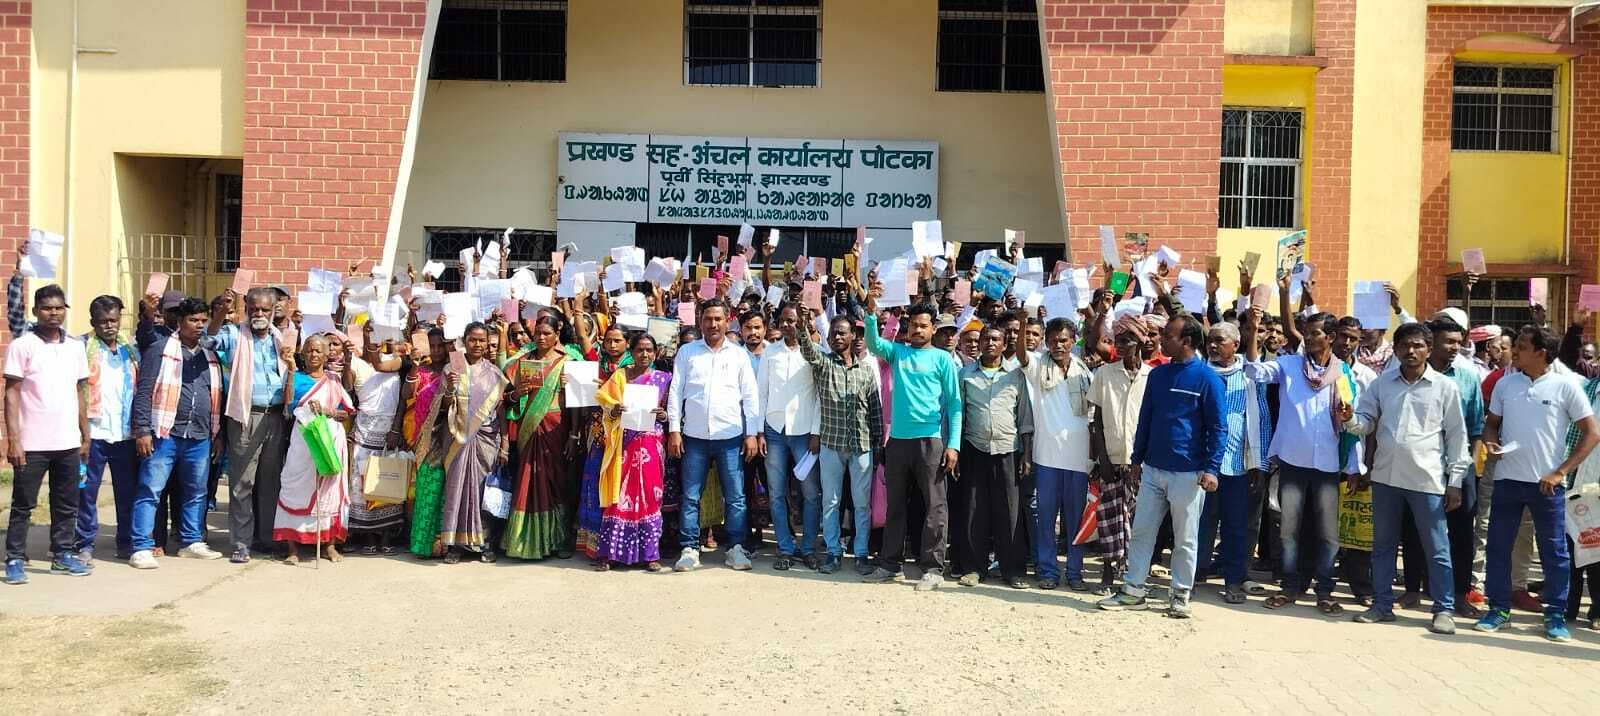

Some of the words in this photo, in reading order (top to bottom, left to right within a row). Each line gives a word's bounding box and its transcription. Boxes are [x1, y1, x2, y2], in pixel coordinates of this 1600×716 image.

[566, 141, 637, 162] प्रखण्ड
[757, 141, 854, 168] कार्यालय
[860, 144, 934, 170] पोटका
[659, 167, 694, 187] पूर्वी
[760, 173, 831, 188] झारखण्ड
